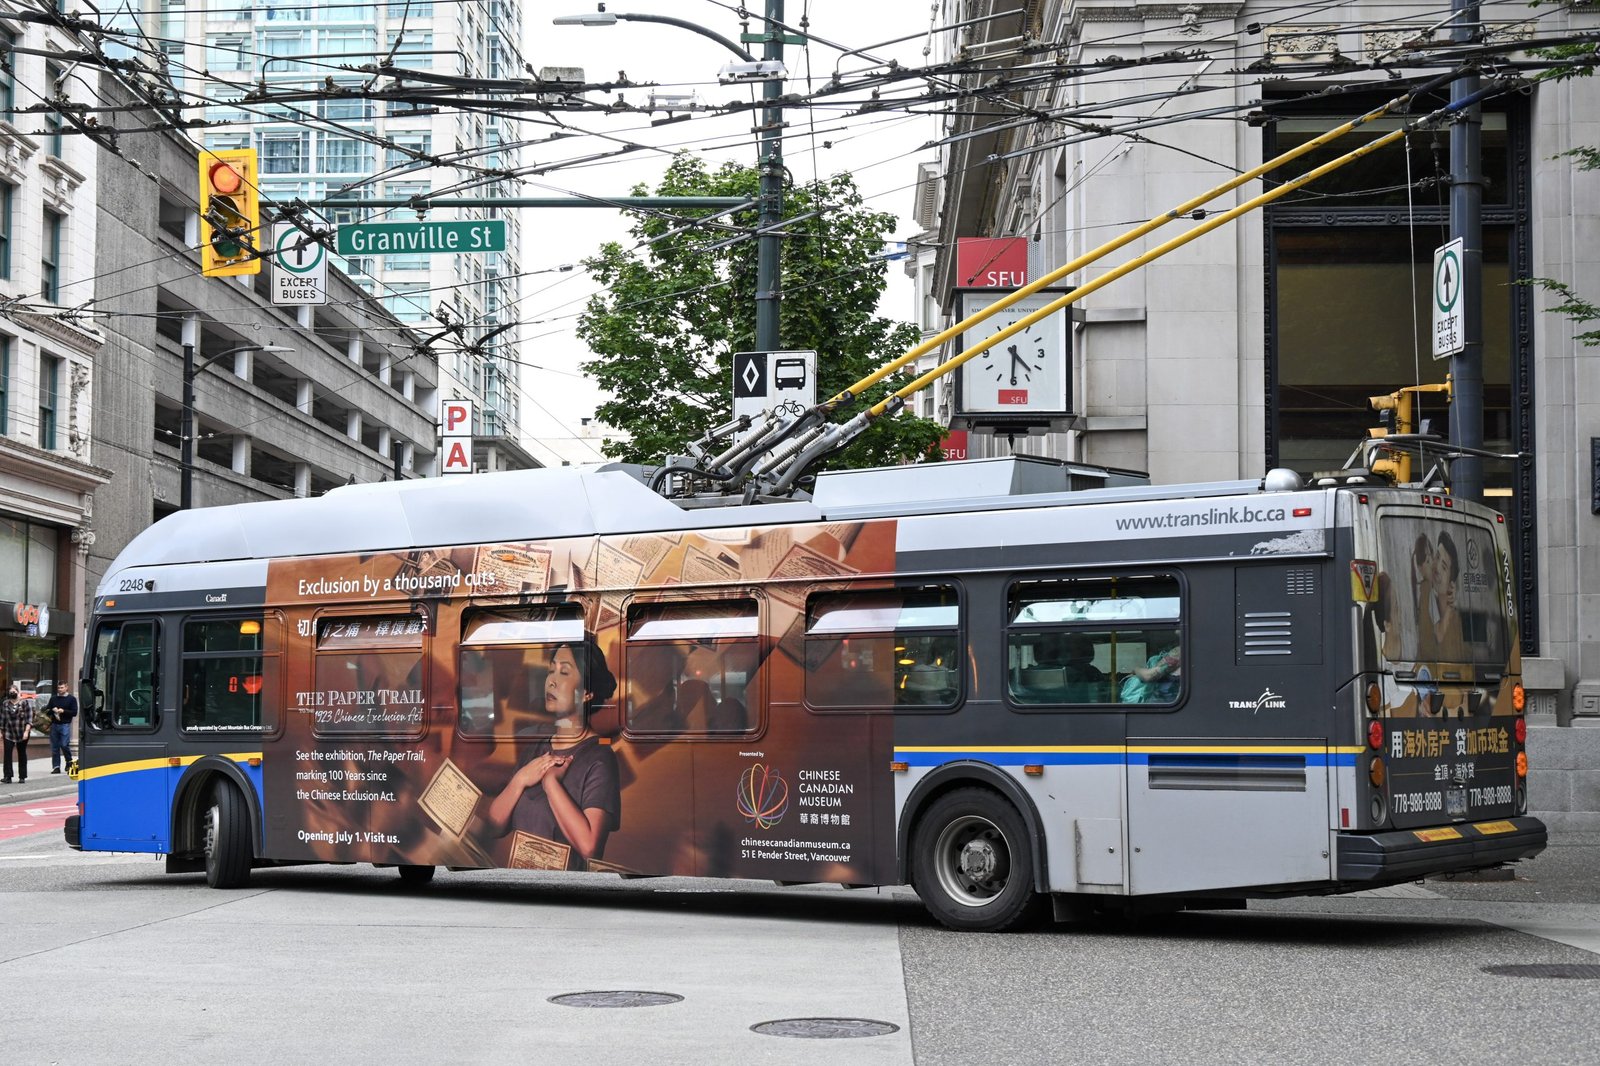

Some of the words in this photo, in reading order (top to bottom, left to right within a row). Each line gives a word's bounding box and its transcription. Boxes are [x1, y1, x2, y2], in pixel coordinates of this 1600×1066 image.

[351, 226, 459, 251] Granville
[470, 226, 492, 248] St
[280, 277, 319, 287] EXCEPT
[987, 271, 1024, 287] SFU
[282, 289, 316, 299] BUSES
[1437, 315, 1457, 332] EXCEPT
[1438, 331, 1456, 348] BUSES
[1037, 348, 1045, 358] 3
[1010, 396, 1027, 404] SFU
[943, 448, 966, 459] SFU
[1116, 506, 1286, 531] www.translink.bc.ca
[119, 578, 144, 592] 2248
[298, 576, 359, 596] Exclusion
[363, 575, 380, 596] by
[383, 578, 391, 591] a
[394, 569, 461, 591] thousand
[465, 571, 499, 586] cuts.
[1502, 549, 1514, 617] 2248
[205, 593, 228, 603] Canada
[296, 691, 325, 706] THE
[327, 690, 375, 706] PAPER
[377, 689, 425, 705] TRAIL
[315, 710, 333, 723] 1923
[333, 708, 365, 723] Chinese
[367, 707, 406, 723] Exclusion
[407, 706, 424, 724] Act
[1391, 729, 1450, 758] 用海外房产
[1455, 726, 1509, 756] 贷加币现金
[295, 750, 309, 760] See
[310, 750, 324, 760] the
[325, 750, 366, 763] exhibition,
[367, 750, 381, 761] The
[383, 750, 406, 764] Paper
[406, 750, 426, 763] Trail,
[296, 770, 327, 783] marking
[328, 770, 344, 781] 100
[344, 770, 366, 781] Years
[366, 770, 387, 781] since
[798, 770, 841, 781] CHINESE
[798, 783, 854, 794] CANADIAN
[296, 790, 310, 800] the
[310, 790, 341, 800] Chinese
[342, 790, 379, 801] Exclusion
[380, 791, 396, 802] Act.
[799, 796, 842, 807] MUSEUM
[1393, 791, 1442, 814] 778-988-8888
[1469, 785, 1512, 807] 778-988-8888
[799, 813, 851, 826] 華裔博物館
[297, 830, 334, 844] Opening
[335, 831, 353, 845] July
[354, 832, 363, 842] 1.
[363, 832, 385, 843] Visit
[386, 834, 400, 844] us.
[741, 837, 851, 850] chinesecanadianmuseum.ca
[741, 850, 750, 859] 51
[751, 850, 756, 859] E
[757, 850, 783, 860] Pender
[784, 851, 810, 862] Street,
[810, 852, 851, 863] Vancouver
